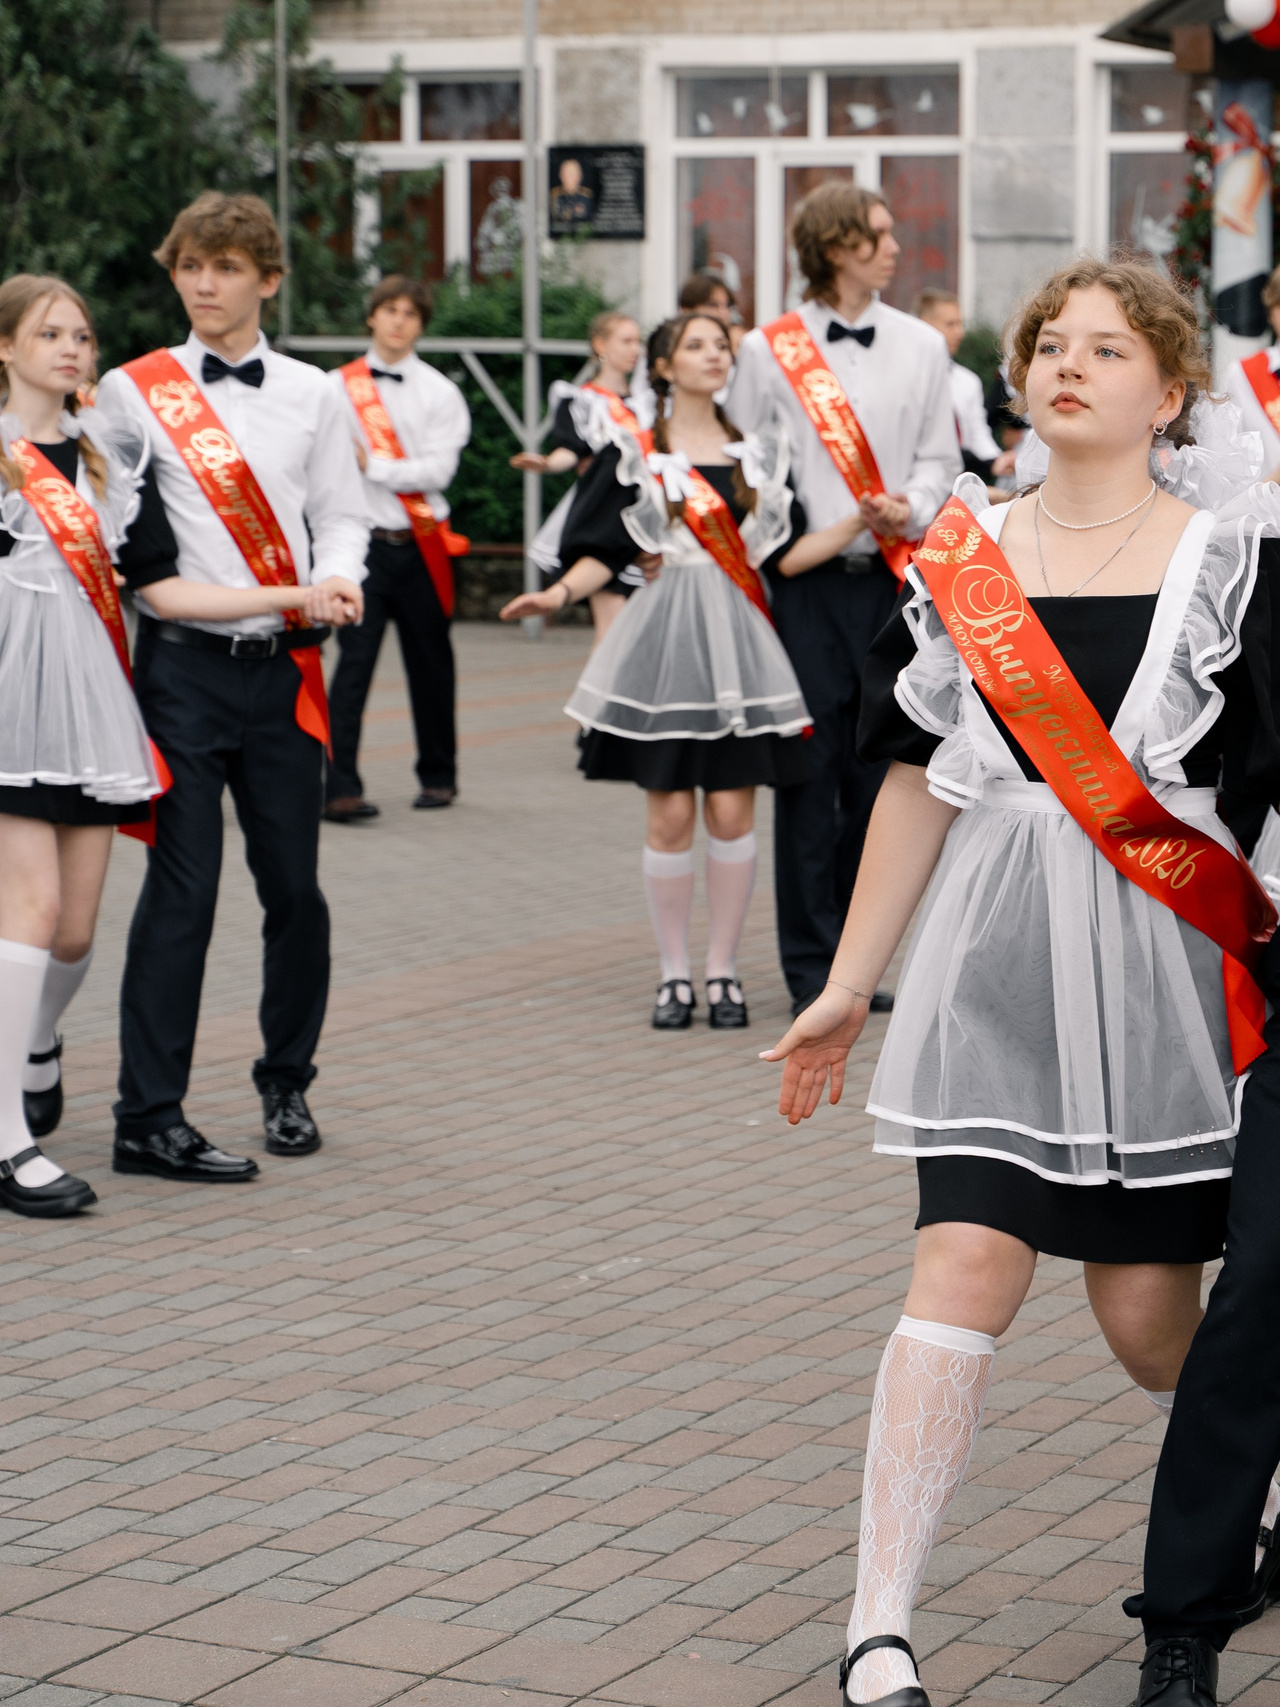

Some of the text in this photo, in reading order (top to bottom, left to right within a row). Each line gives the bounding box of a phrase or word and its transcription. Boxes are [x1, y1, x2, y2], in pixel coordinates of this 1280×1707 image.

[944, 610, 975, 649] МАОУ
[965, 650, 991, 680] СОШ
[951, 564, 1207, 890] Выпускница 2026
[1042, 663, 1121, 774] Моря Мария
